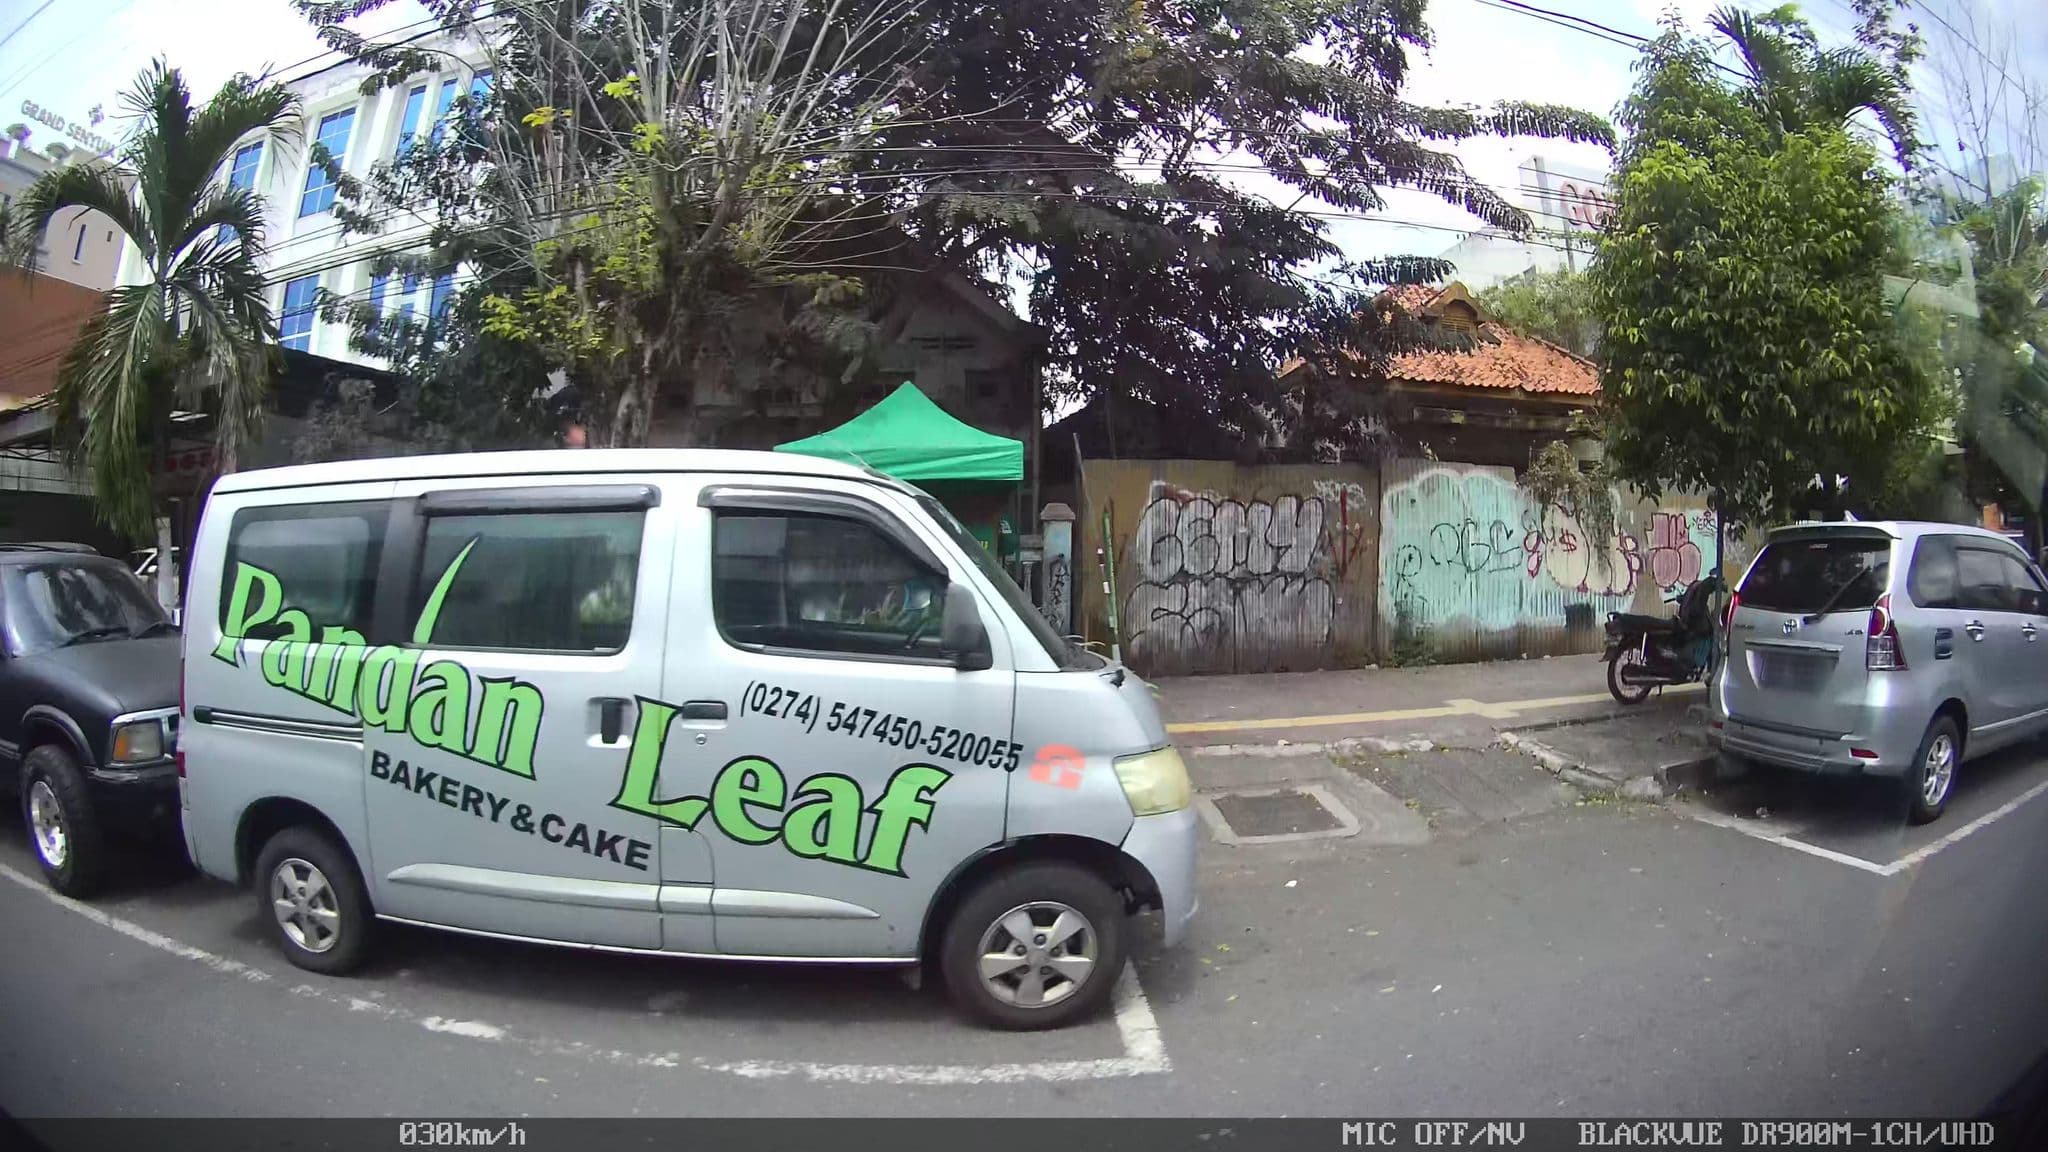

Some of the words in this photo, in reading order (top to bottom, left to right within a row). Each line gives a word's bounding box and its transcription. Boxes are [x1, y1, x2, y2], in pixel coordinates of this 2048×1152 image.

[21, 99, 65, 132] GRAND
[210, 536, 545, 781] Pandan
[609, 694, 953, 879] Leaf
[740, 680, 821, 735] (0274)
[827, 702, 1024, 773] 547450-520055
